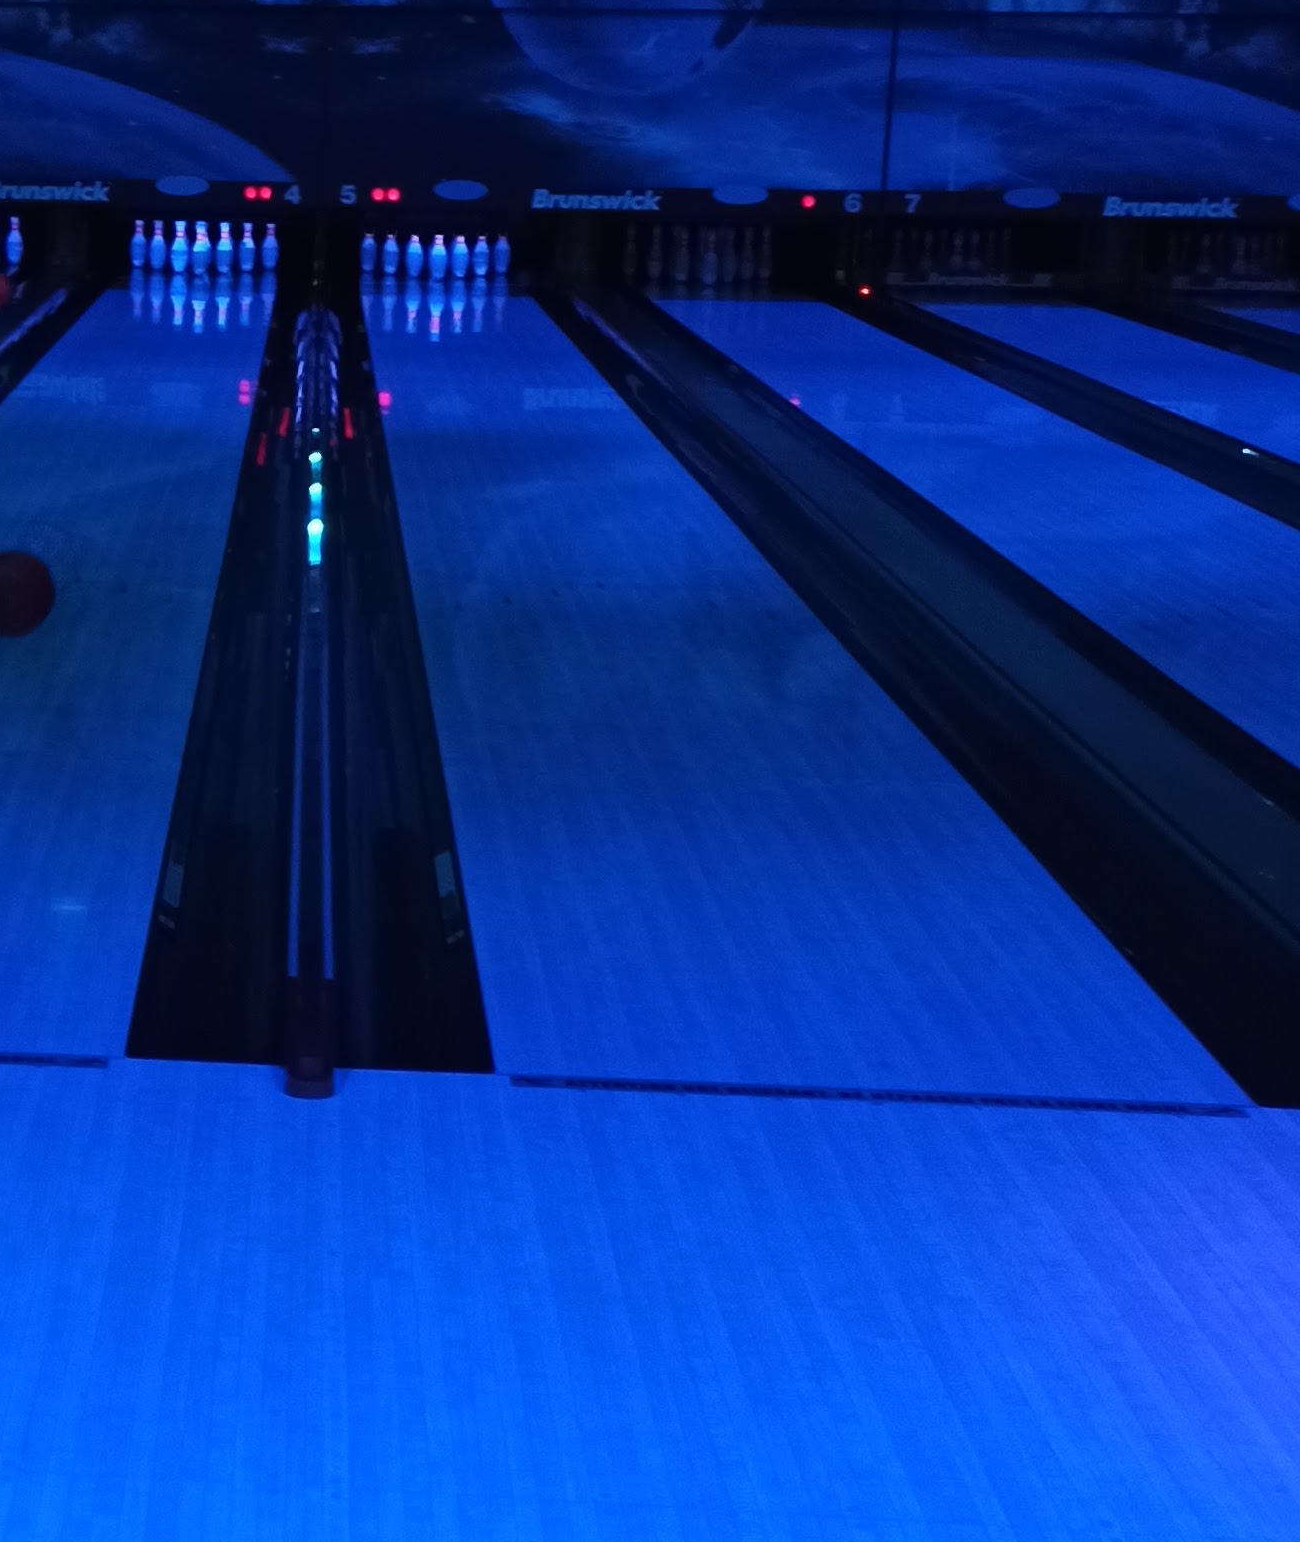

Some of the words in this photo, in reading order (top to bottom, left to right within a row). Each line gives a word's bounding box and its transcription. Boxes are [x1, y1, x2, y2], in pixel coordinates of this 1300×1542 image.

[284, 184, 303, 204] 4
[340, 184, 357, 205] 5
[530, 188, 662, 212] Brunswick
[843, 193, 862, 214] 6
[904, 195, 921, 214] 7
[1102, 195, 1238, 220] Brunswick
